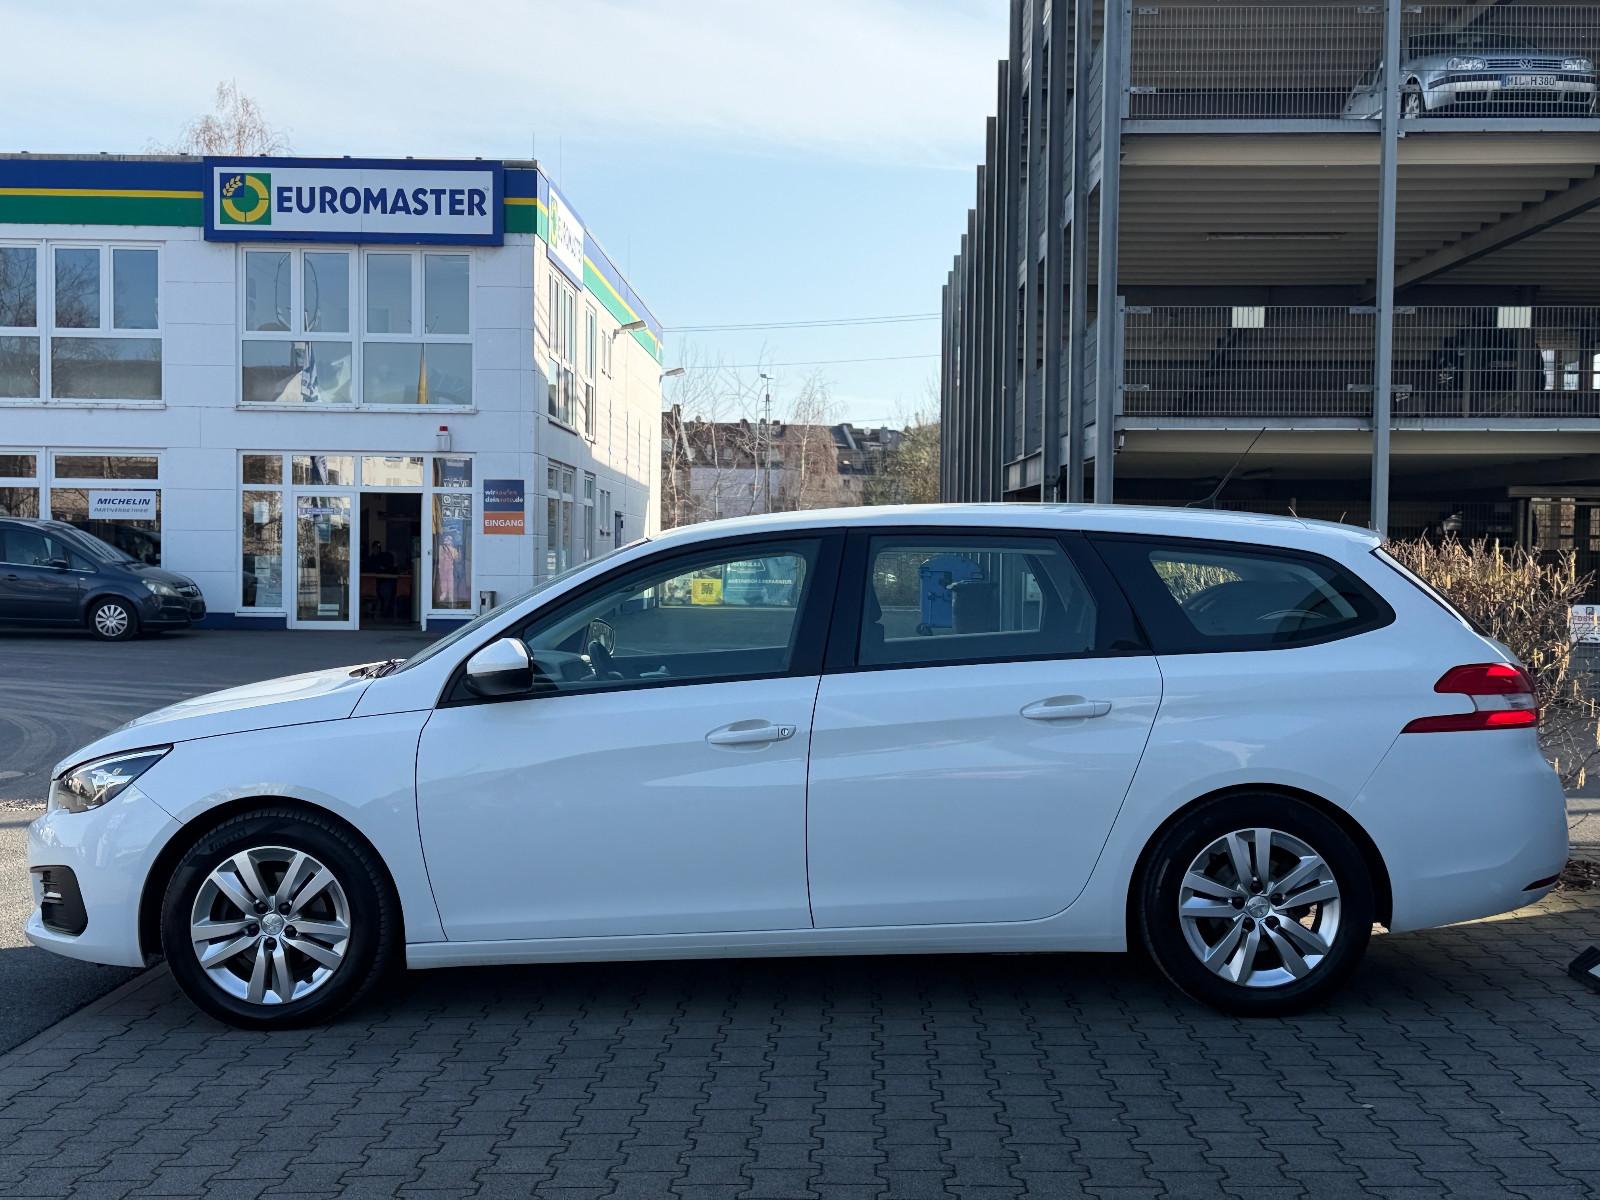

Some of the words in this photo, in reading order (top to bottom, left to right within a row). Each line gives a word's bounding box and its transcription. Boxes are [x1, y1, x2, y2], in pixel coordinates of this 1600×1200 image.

[276, 186, 488, 217] EUROMASTER
[97, 498, 151, 506] MICHELIN
[484, 519, 524, 527] EINGANG
